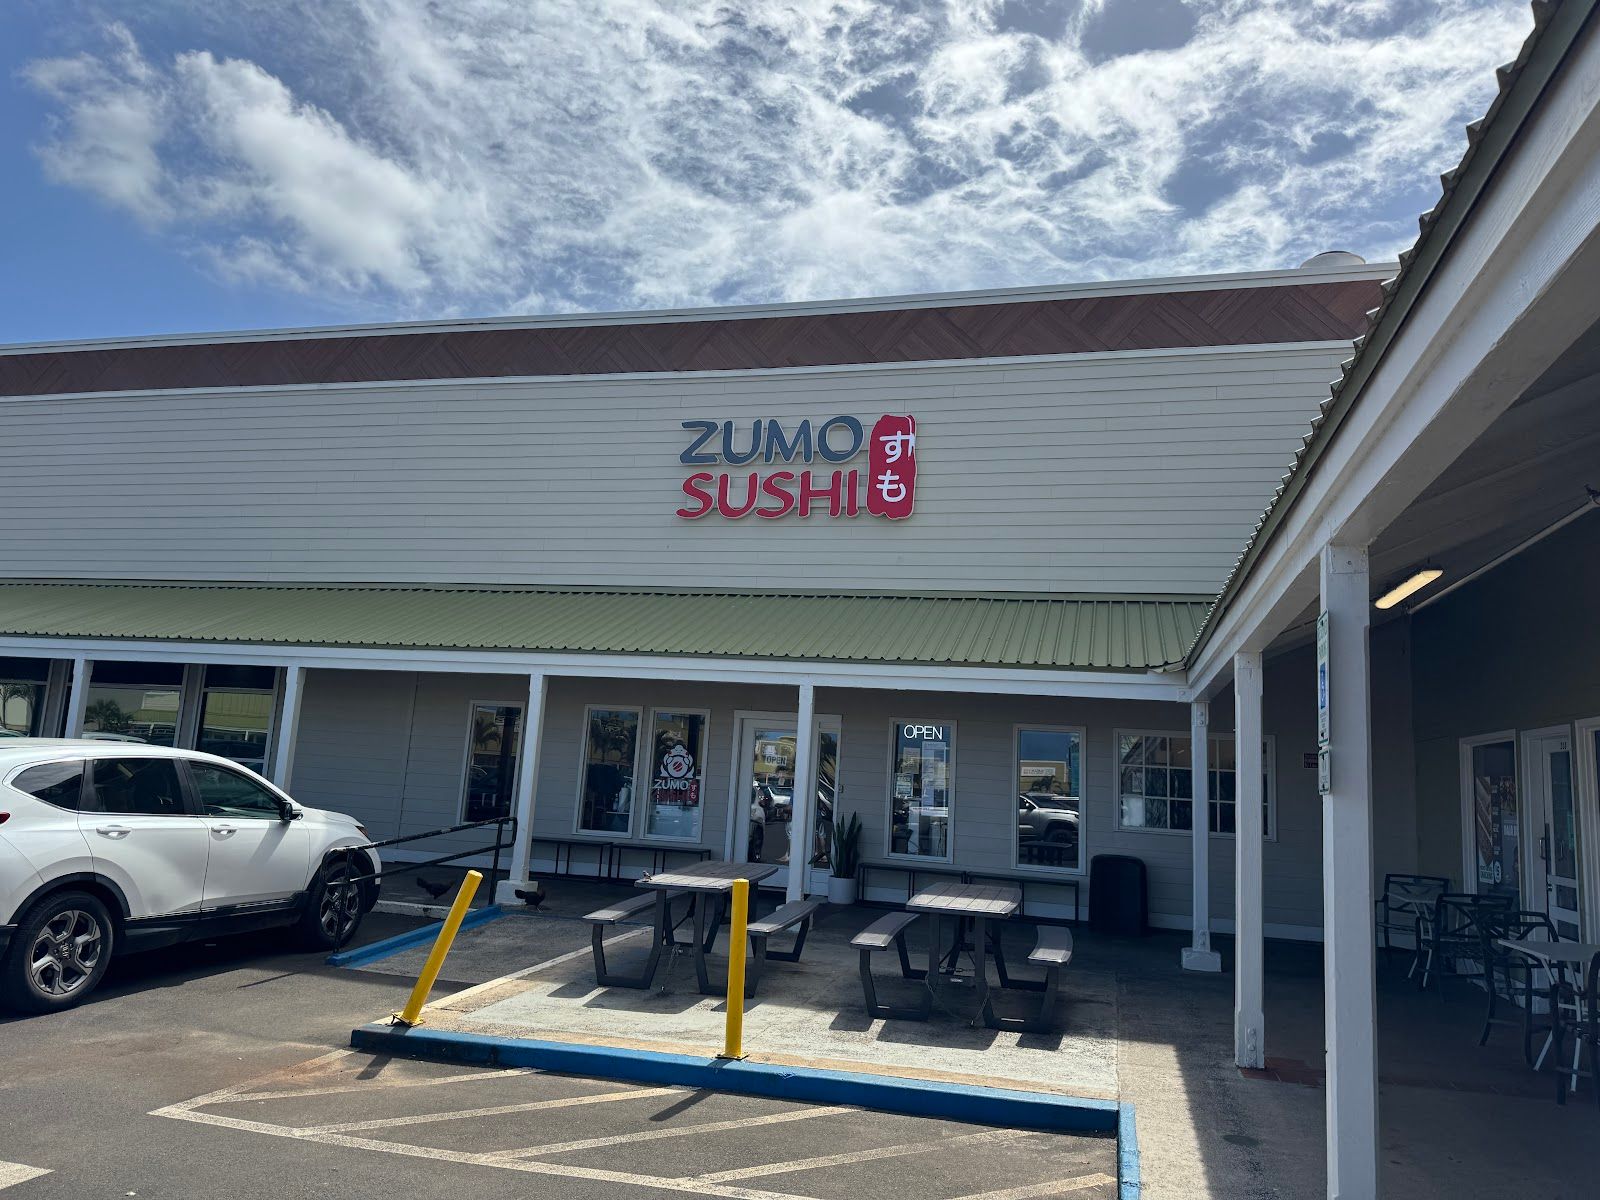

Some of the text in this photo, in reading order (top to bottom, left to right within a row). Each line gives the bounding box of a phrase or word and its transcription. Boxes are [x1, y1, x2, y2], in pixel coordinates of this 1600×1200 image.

[679, 416, 865, 466] ZUMO
[876, 430, 916, 502] すも
[676, 469, 860, 519] SUSHI
[903, 724, 943, 740] OPEN
[766, 755, 787, 765] OPEN
[653, 779, 689, 790] ZUMO
